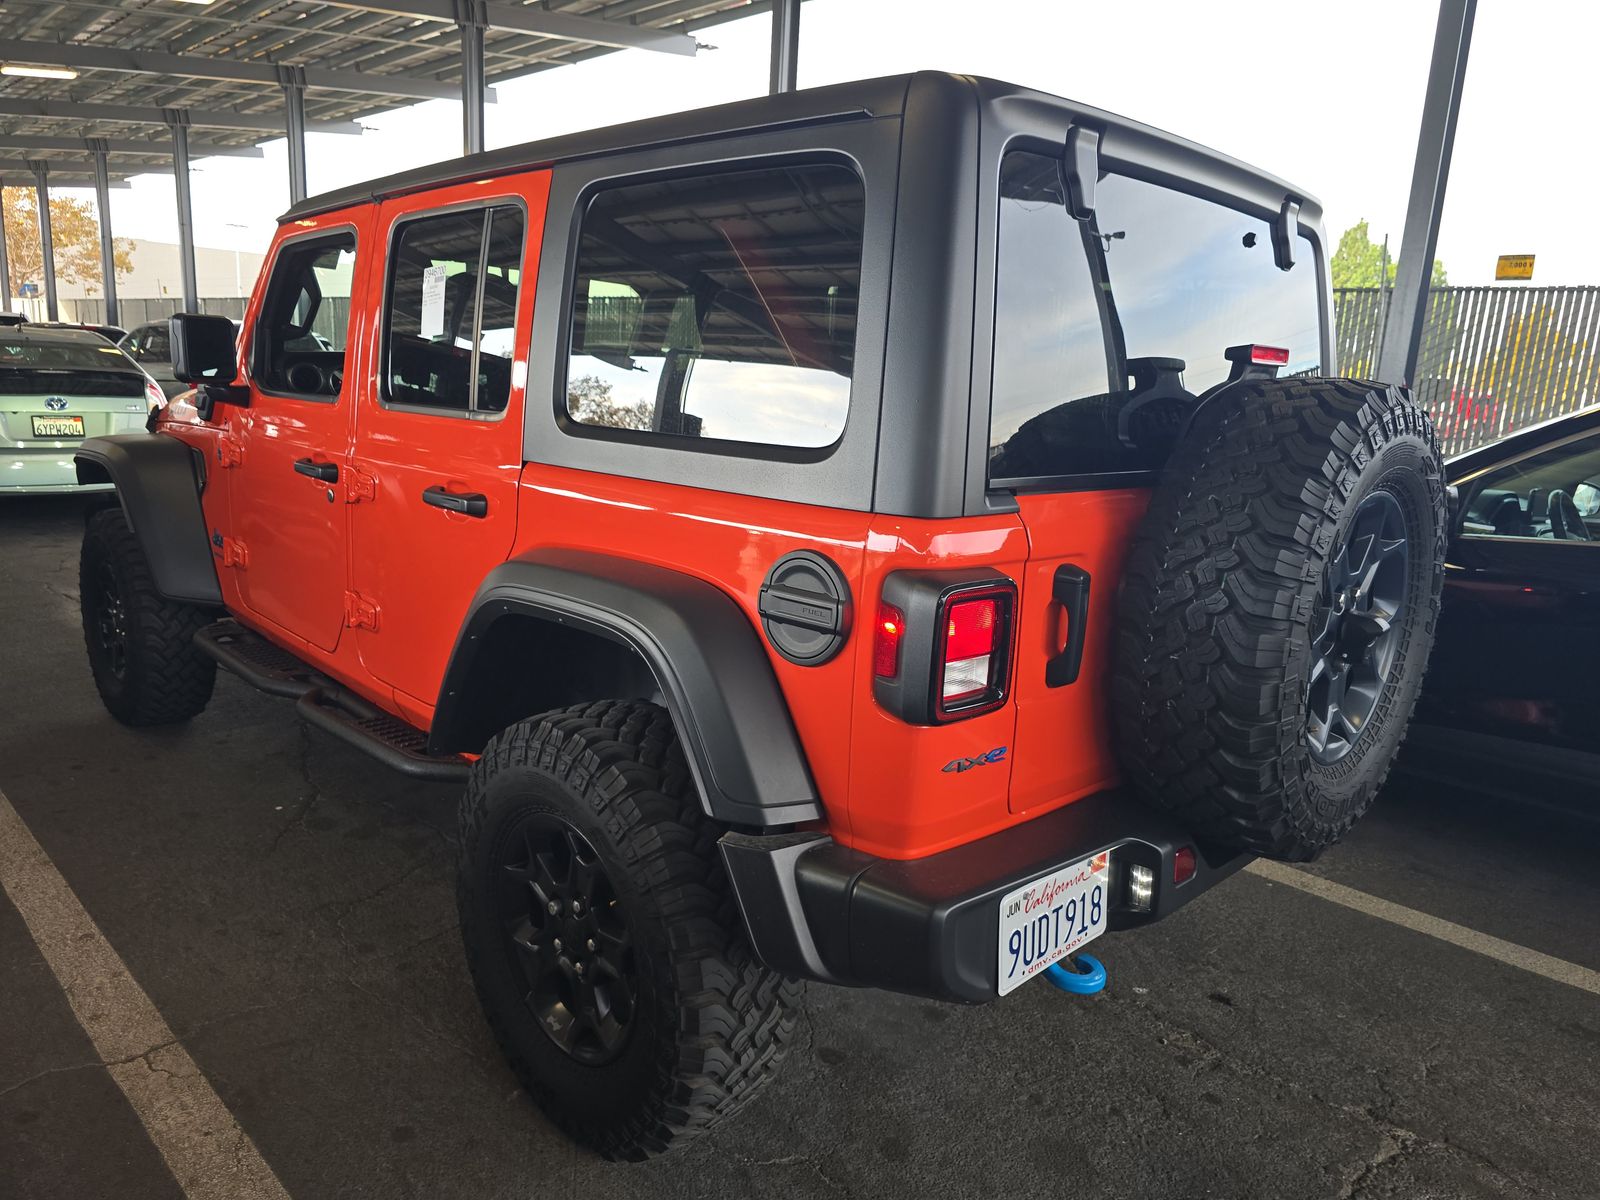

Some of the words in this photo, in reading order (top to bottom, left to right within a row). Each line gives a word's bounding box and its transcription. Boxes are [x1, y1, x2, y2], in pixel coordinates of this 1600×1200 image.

[802, 607, 826, 618] FUEL
[1006, 900, 1021, 918] JUN
[1024, 868, 1092, 914] California
[1008, 885, 1102, 979] 9UDT918
[1028, 936, 1083, 974] dmv.ca.gov
